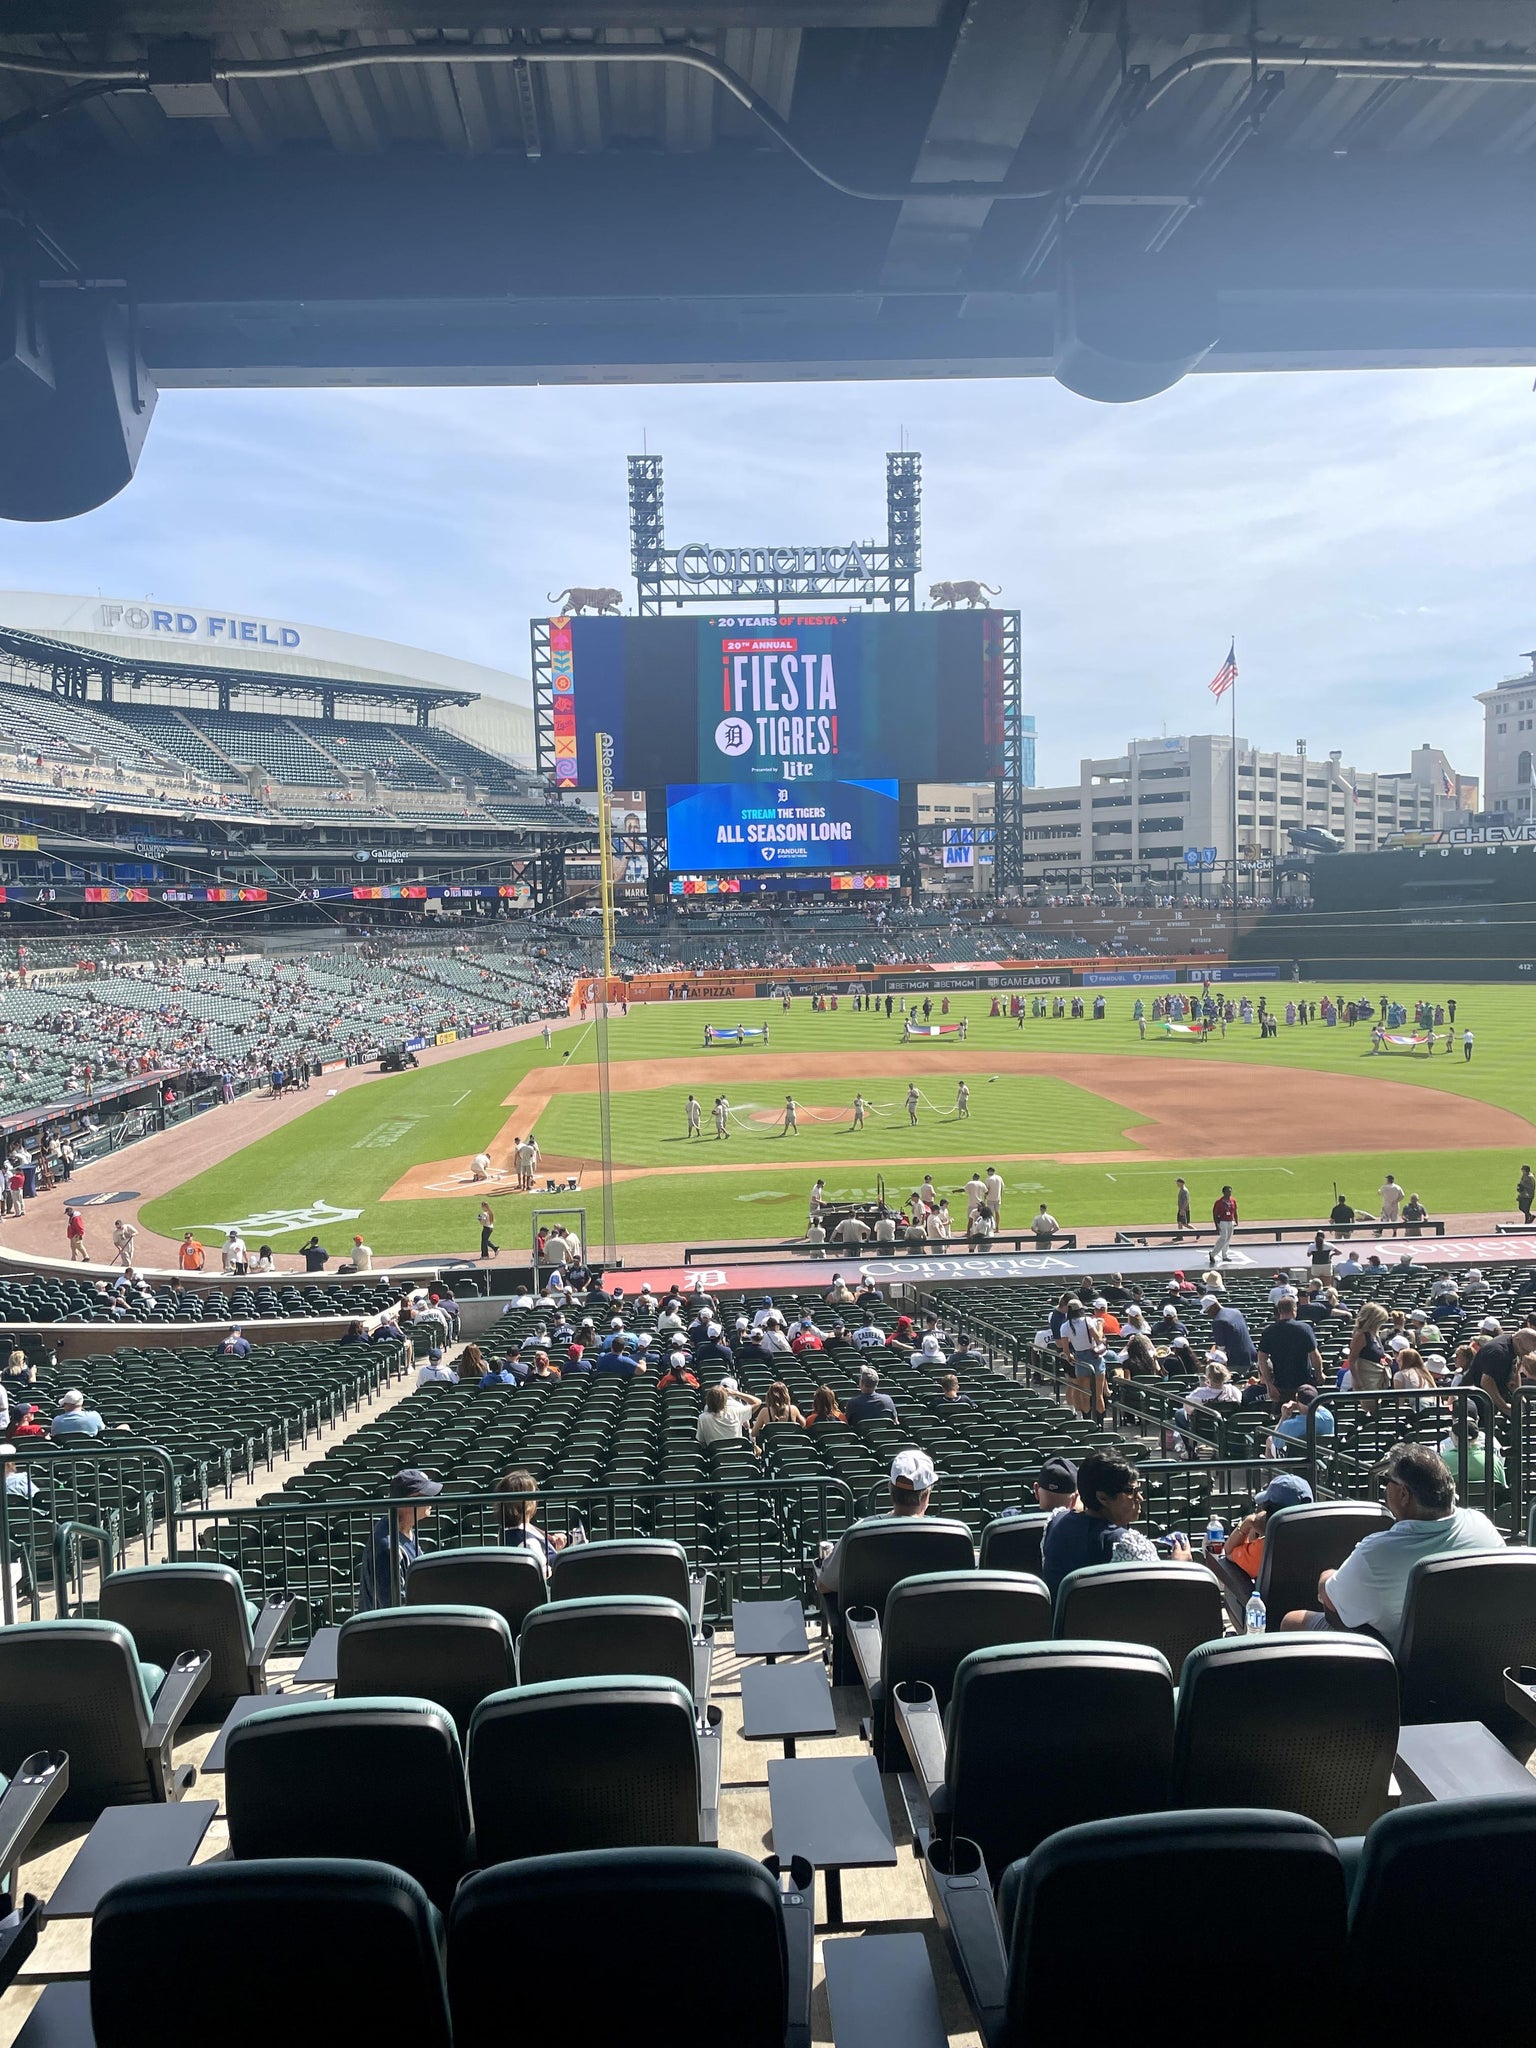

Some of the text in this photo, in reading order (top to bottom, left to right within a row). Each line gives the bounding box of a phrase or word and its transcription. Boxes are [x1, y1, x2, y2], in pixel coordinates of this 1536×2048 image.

[731, 577, 821, 593] PARK
[100, 604, 301, 648] FORD FIELD
[718, 615, 838, 627] 20 YEARS OF FIESTA
[751, 641, 793, 650] ANNUAL
[756, 716, 839, 756] TIGRES!
[782, 761, 814, 781] Lite
[741, 807, 826, 820] STREAM THE TIGERS
[717, 822, 852, 843] ALL SEASON LONG
[136, 843, 170, 854] CHAMPIONS
[371, 849, 410, 859] Gallagher
[947, 846, 970, 863] ANY
[1137, 910, 1143, 919] 2
[1175, 911, 1182, 920] 16
[1117, 926, 1126, 934] 47
[1191, 970, 1221, 981] DTE
[941, 980, 975, 988] BETMGM
[1001, 976, 1061, 987] GAMEABOVE
[703, 987, 735, 997] PIZZA!
[924, 1269, 1023, 1278] PARK
[224, 1344, 234, 1354] 4
